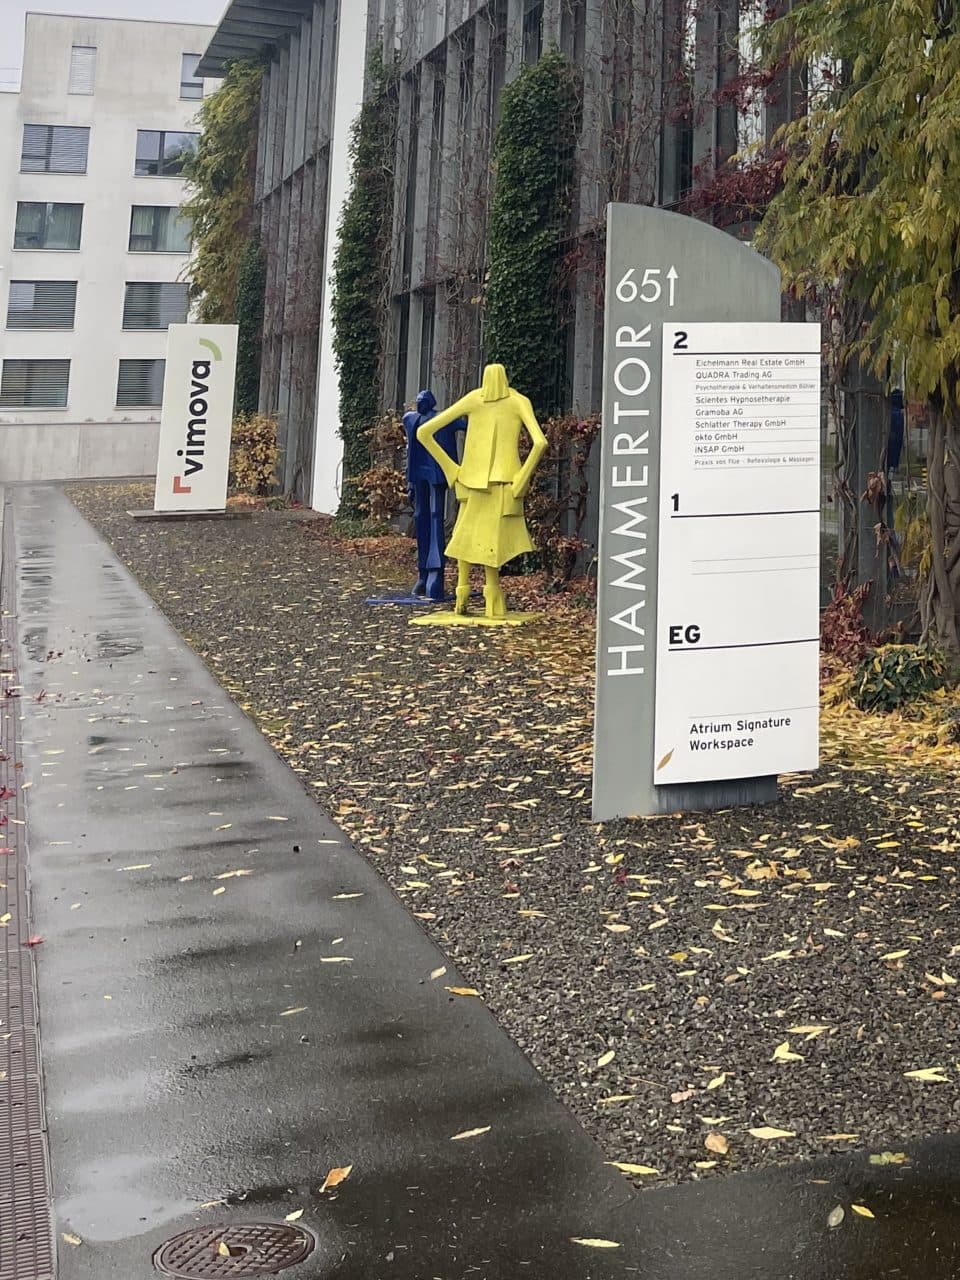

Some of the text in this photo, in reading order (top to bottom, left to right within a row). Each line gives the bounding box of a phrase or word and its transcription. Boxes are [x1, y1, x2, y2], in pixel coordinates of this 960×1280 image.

[615, 267, 662, 304] 65
[673, 331, 688, 350] 2
[695, 358, 805, 367] Eichelmann Real Estate GmbH
[695, 370, 773, 380] QUADRA Trading AG
[695, 394, 790, 404] Scientes Hypnosetherapie
[177, 360, 211, 477] vimova
[695, 407, 744, 417] Gramoba AG
[695, 418, 787, 429] Schlatter Therapy GmbH
[694, 432, 738, 441] okto GmbH
[721, 444, 745, 453] GmbH
[607, 323, 652, 676] HAMMERTOR
[671, 493, 680, 512] 1
[669, 625, 701, 645] EG
[690, 716, 791, 735] Atrium Signature
[689, 736, 754, 752] Workspace
